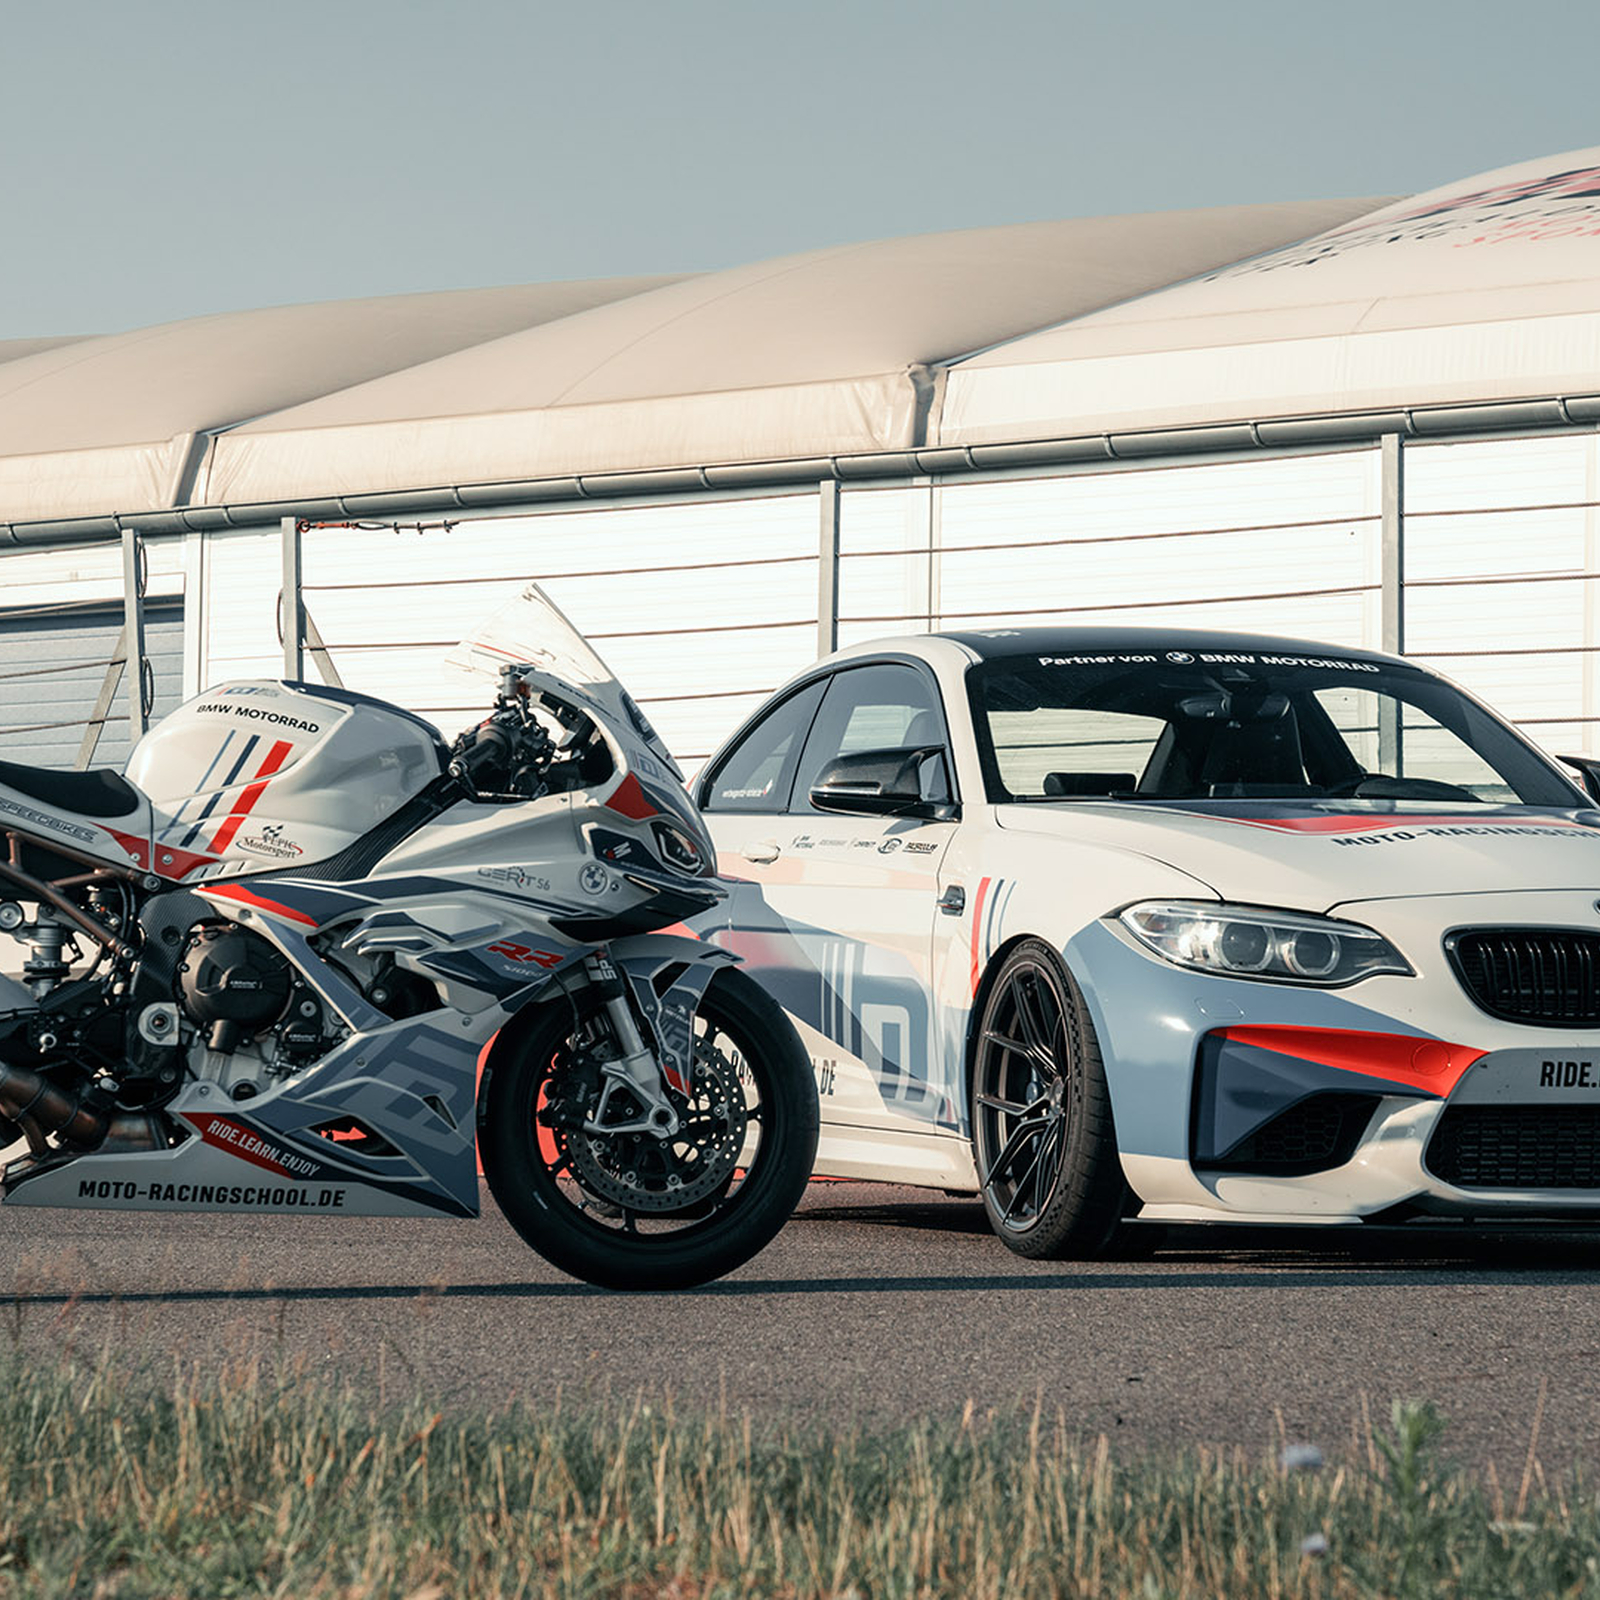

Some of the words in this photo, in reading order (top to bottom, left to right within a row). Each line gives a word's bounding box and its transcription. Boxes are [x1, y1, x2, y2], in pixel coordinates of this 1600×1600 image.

[1038, 655, 1116, 667] Partner
[1118, 654, 1158, 663] von
[1199, 653, 1256, 664] BMW
[1260, 655, 1381, 673] MOTORRAD
[196, 704, 233, 714] BMW
[234, 706, 320, 734] MOTORRAD
[243, 837, 297, 858] Motorsport
[485, 940, 564, 969] RR
[1540, 1061, 1600, 1089] RIDE.
[206, 1119, 321, 1177] RIDE.LEARN.ENJOY
[78, 1180, 347, 1208] MOTO-RACINGSCHOOL.DE
